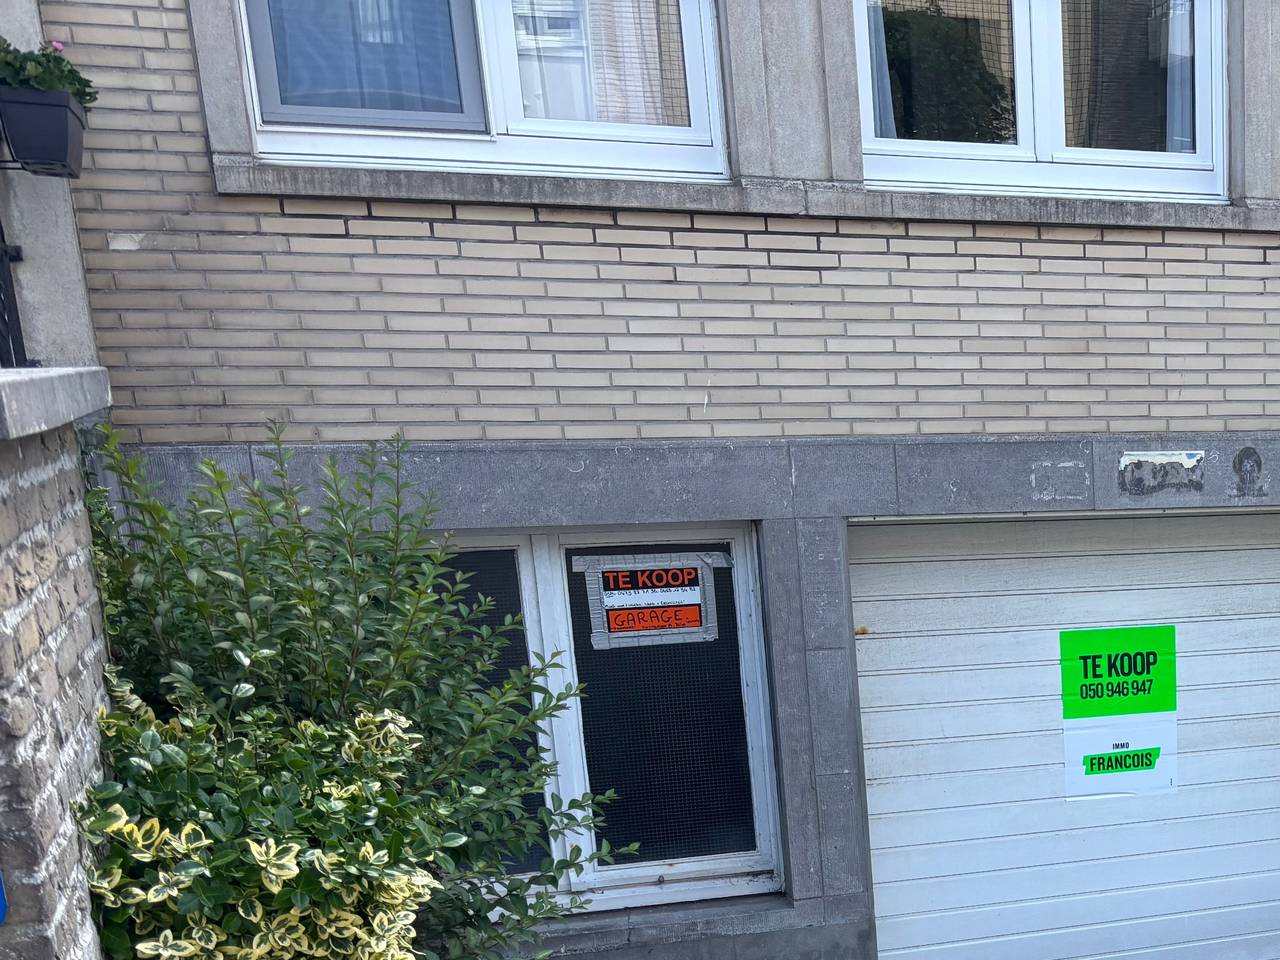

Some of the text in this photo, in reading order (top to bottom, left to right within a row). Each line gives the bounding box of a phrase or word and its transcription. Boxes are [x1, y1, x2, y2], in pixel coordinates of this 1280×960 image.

[604, 568, 696, 589] TE KOOP
[1079, 651, 1158, 679] TE KOOP
[1080, 679, 1154, 700] 050 946 947
[1112, 742, 1130, 750] IMMO
[1090, 752, 1153, 772] FRANCOIS
